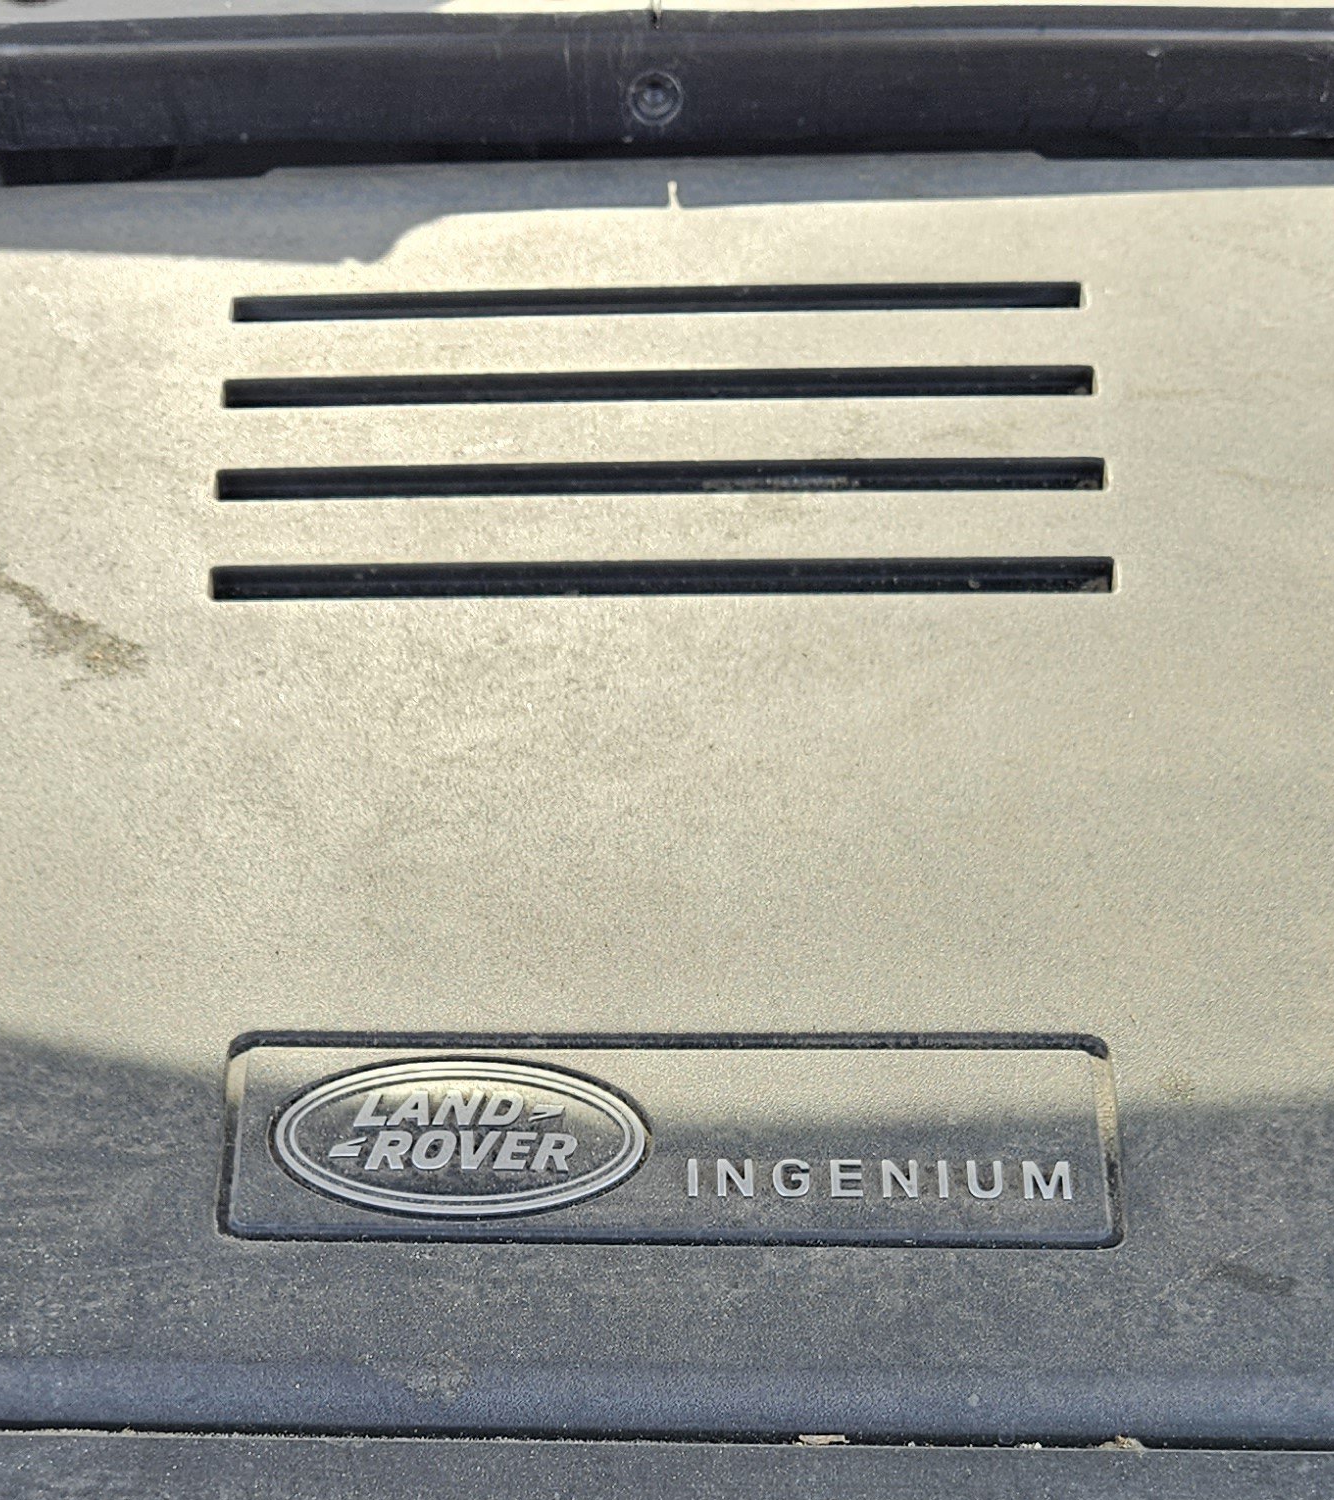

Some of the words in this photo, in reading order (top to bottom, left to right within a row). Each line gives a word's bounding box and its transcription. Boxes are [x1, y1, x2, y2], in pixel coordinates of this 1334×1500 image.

[354, 1090, 524, 1130] LAND
[363, 1131, 579, 1173] ROVER
[686, 1157, 1074, 1201] INGENIUM
